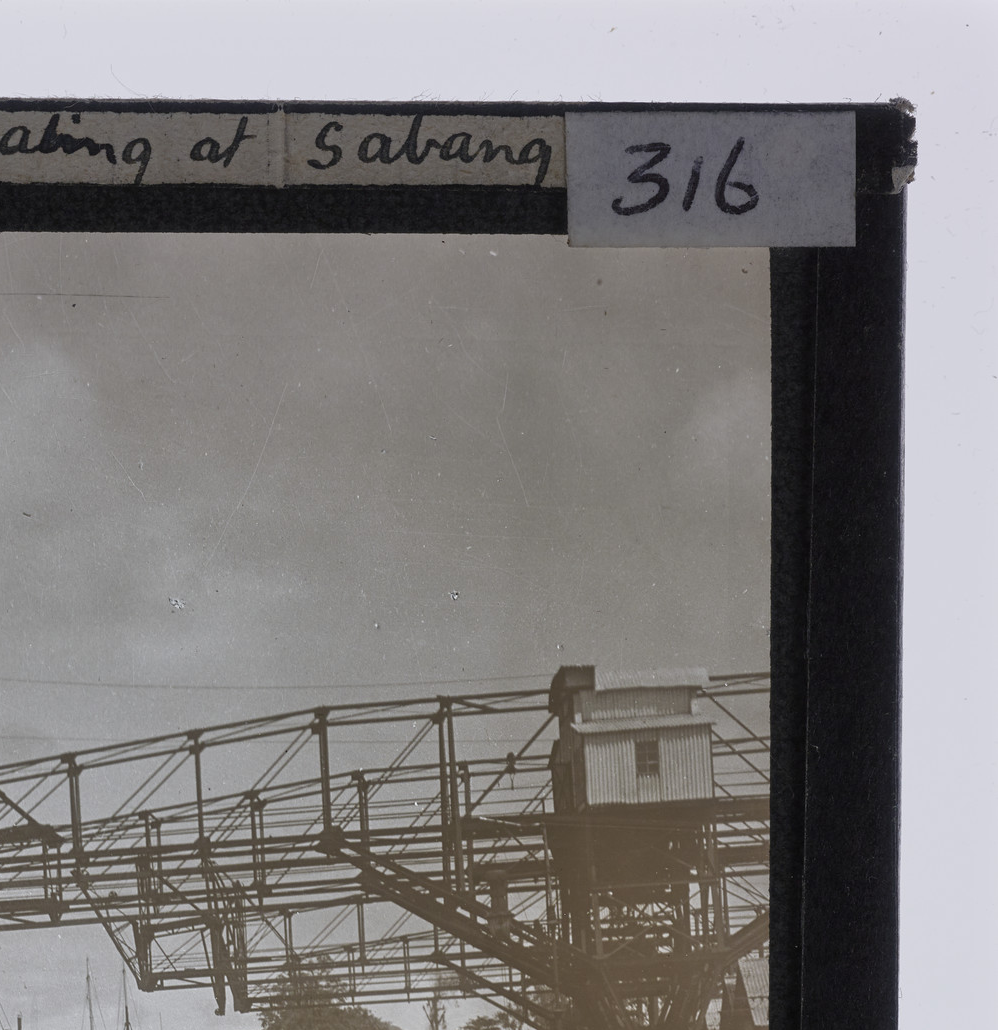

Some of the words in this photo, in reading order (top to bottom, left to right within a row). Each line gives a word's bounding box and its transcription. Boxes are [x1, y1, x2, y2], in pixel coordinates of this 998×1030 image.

[189, 115, 258, 168] at
[307, 113, 553, 185] Sabang
[610, 136, 761, 217] 316
